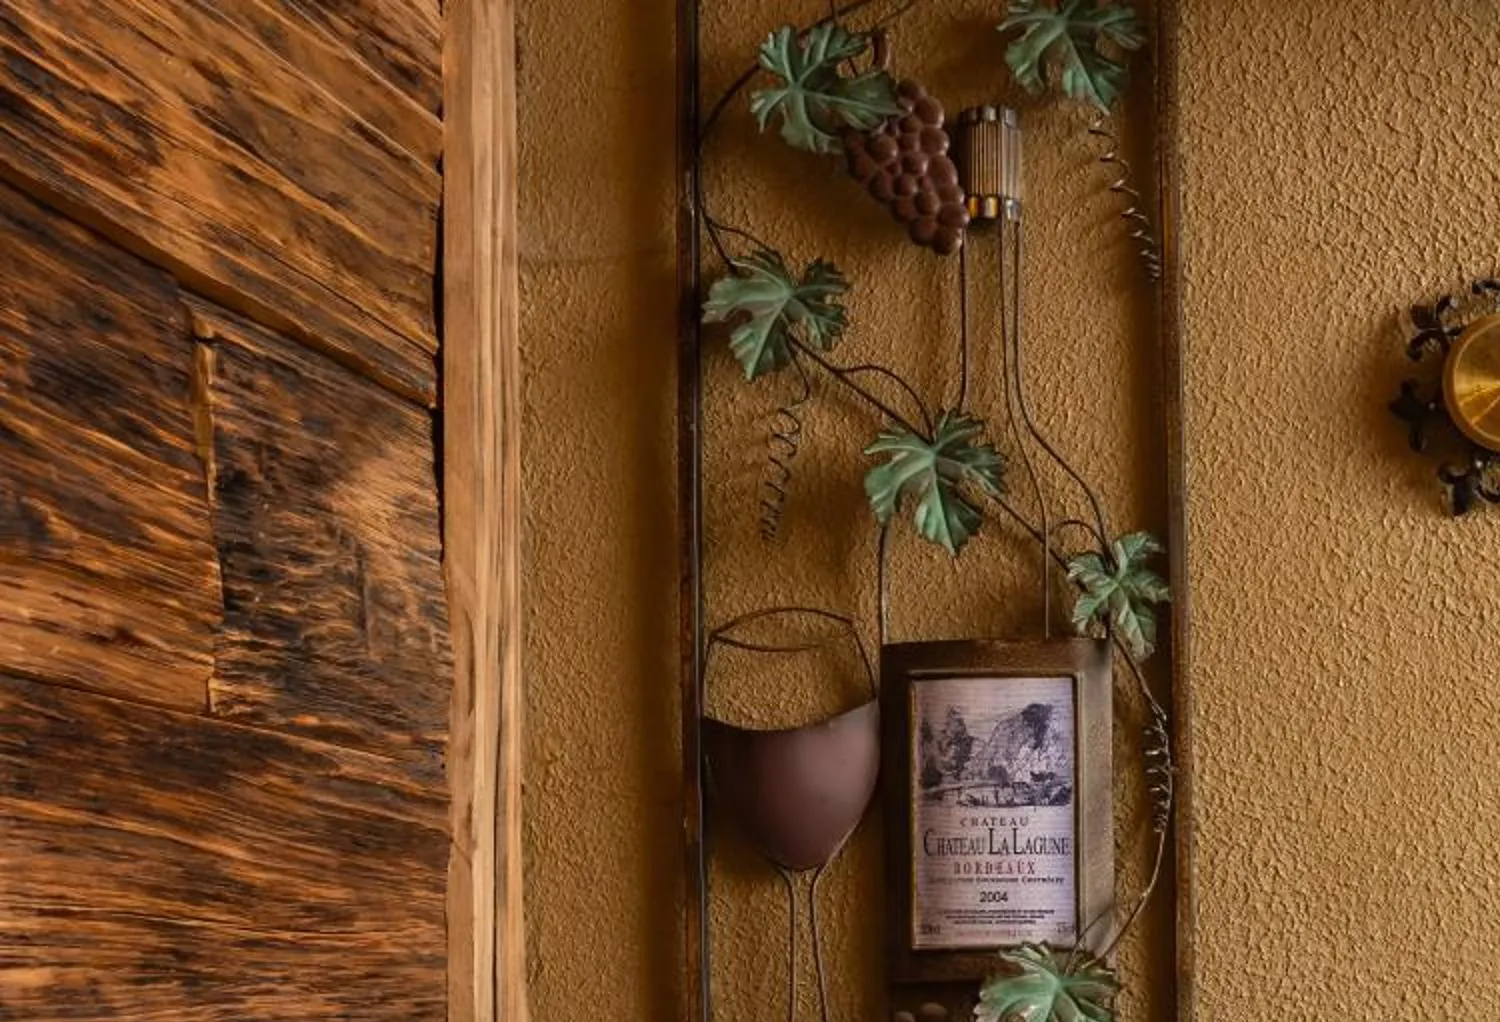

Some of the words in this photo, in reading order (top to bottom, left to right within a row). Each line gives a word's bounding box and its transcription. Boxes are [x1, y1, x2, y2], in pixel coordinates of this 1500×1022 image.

[960, 816, 1029, 827] CHATEAU
[953, 861, 1036, 875] BORDEAUX
[979, 891, 1009, 903] 2004
